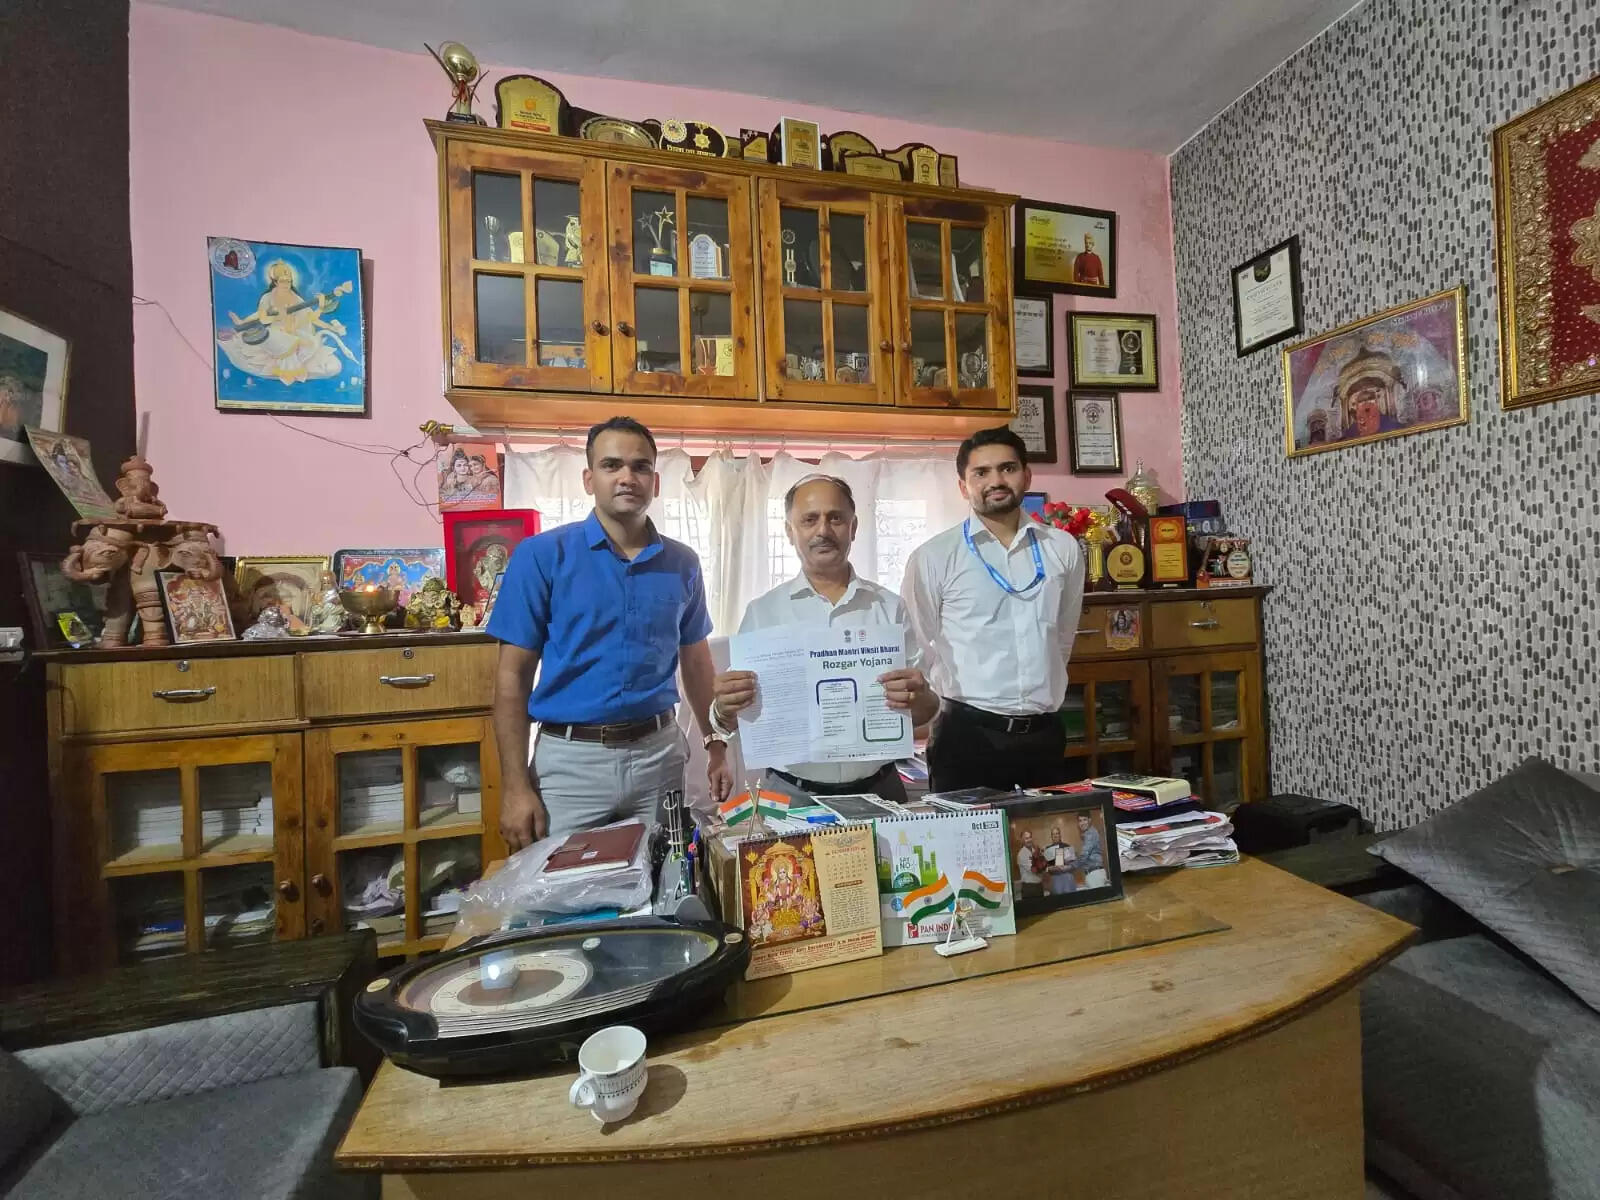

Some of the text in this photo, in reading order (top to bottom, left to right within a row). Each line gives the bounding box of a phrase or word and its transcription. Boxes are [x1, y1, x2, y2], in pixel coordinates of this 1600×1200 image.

[810, 649, 837, 658] Pradhan
[838, 648, 860, 656] Mantri
[860, 646, 879, 655] Viksit
[822, 657, 893, 670] Rozgar Yojana
[920, 924, 934, 933] PAN
